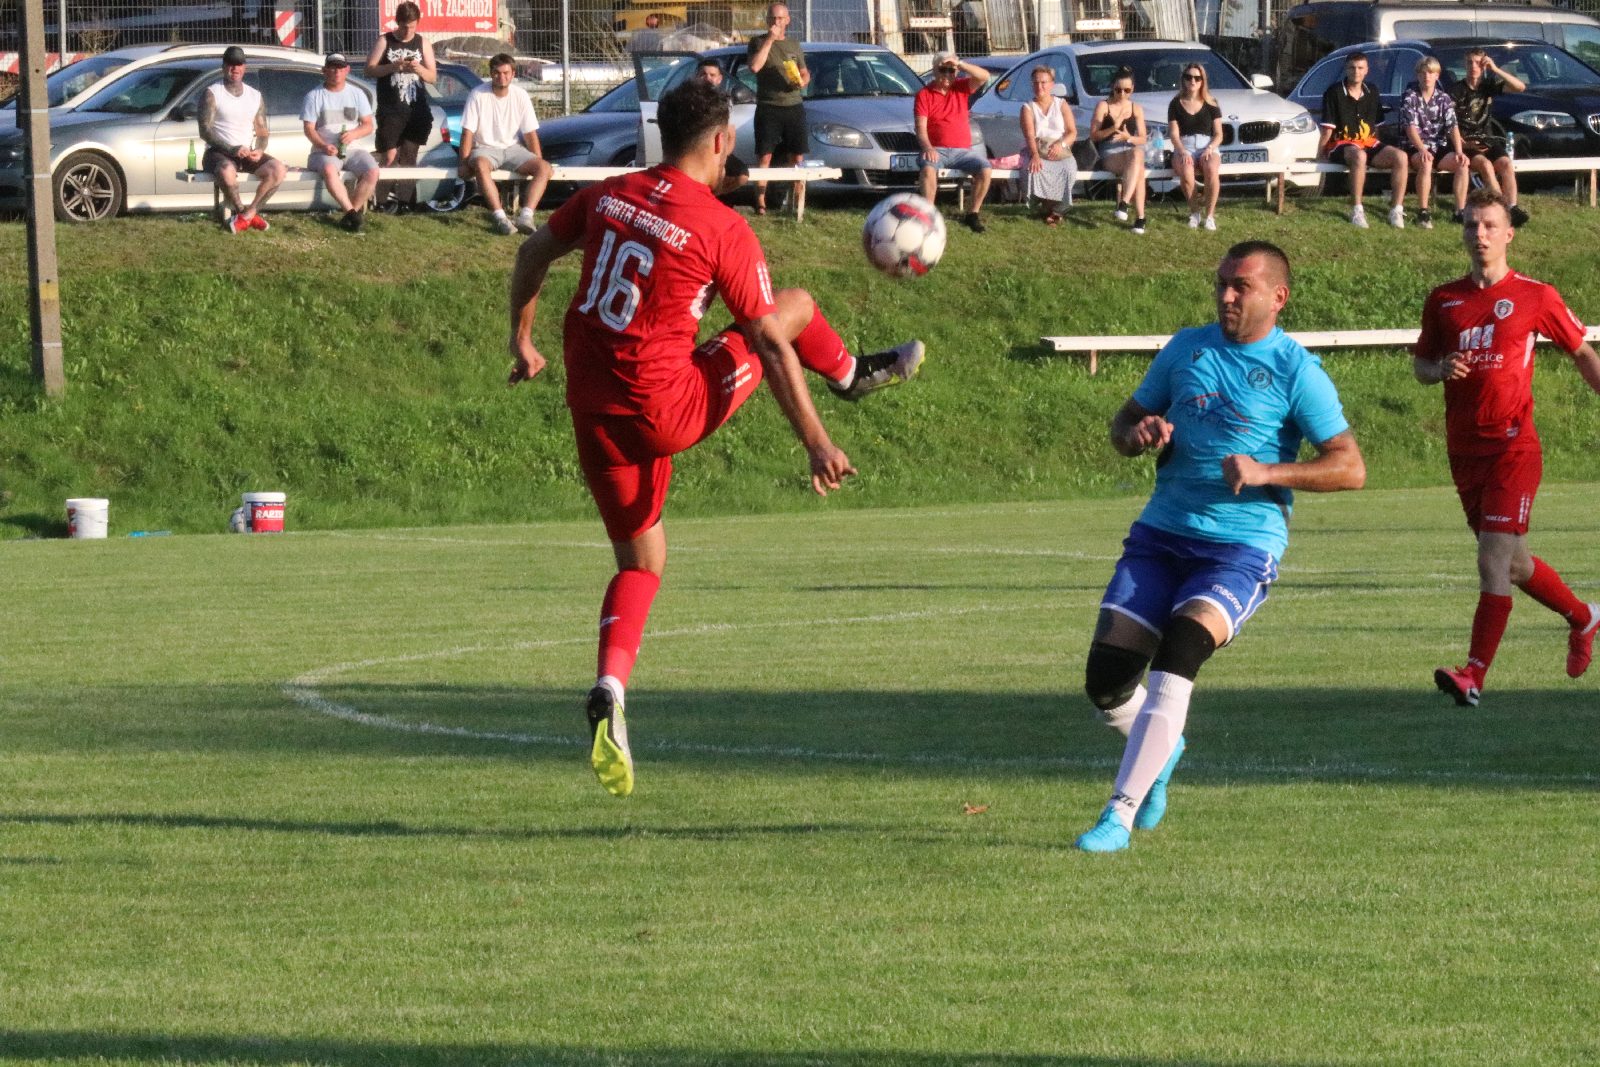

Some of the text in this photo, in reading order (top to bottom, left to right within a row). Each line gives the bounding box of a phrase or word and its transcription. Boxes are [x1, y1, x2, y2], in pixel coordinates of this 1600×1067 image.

[595, 195, 636, 224] SPARTA
[578, 228, 654, 332] 16
[1212, 584, 1243, 613] macron
